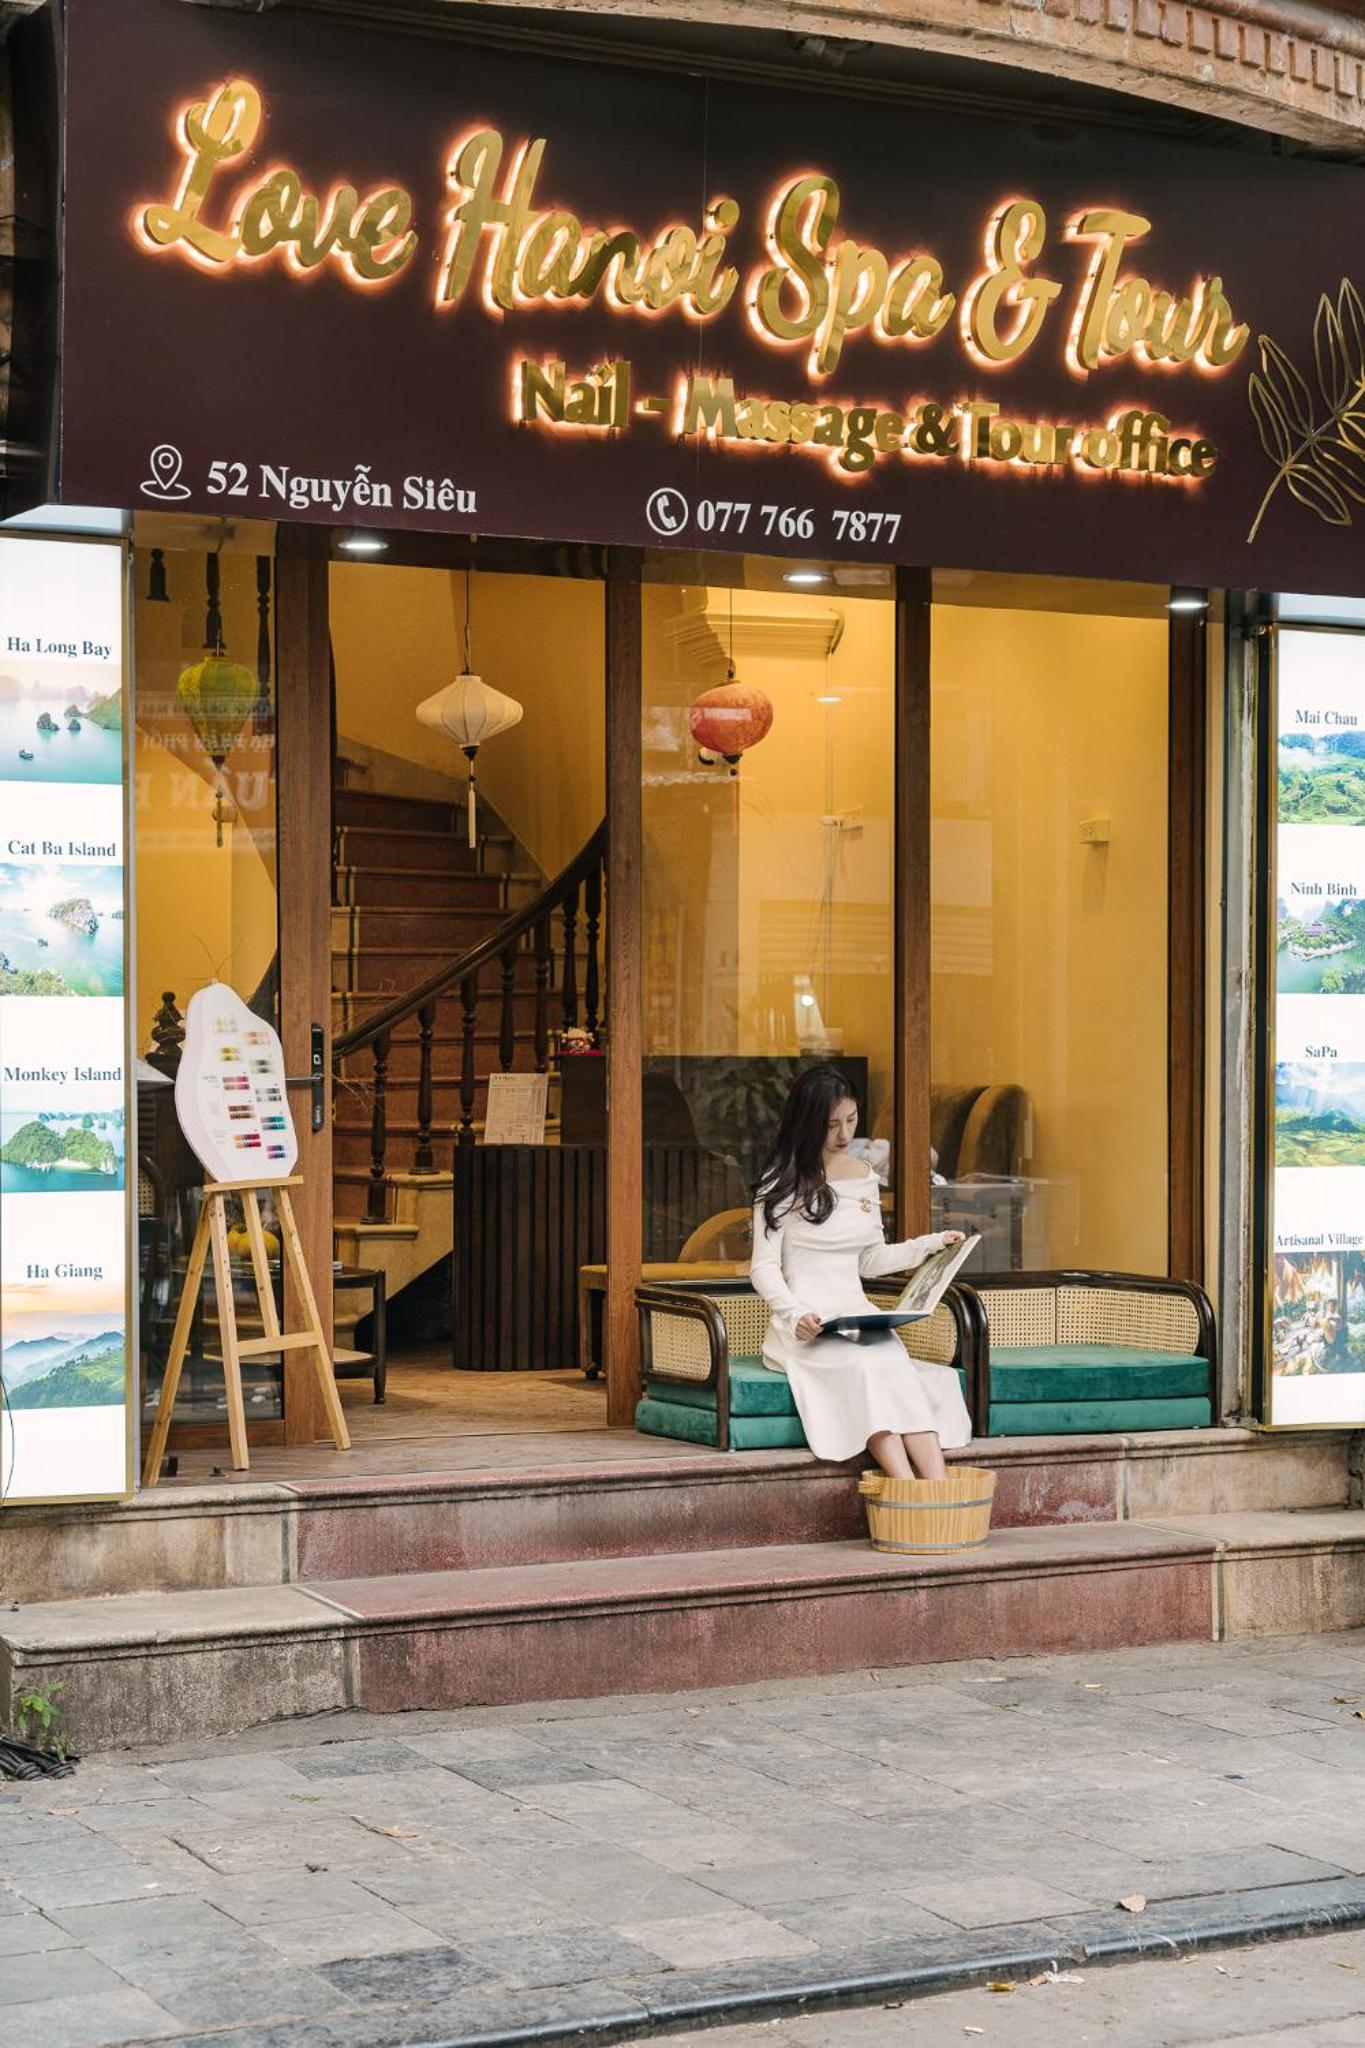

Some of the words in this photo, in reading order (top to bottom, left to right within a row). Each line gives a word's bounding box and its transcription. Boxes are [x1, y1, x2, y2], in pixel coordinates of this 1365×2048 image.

[137, 78, 419, 280] Love
[439, 129, 740, 316] Hanoi
[750, 174, 956, 379] Spa
[962, 198, 1061, 365] &
[1064, 208, 1250, 373] Tour
[515, 358, 631, 427] Nail
[676, 373, 902, 472] Massage
[906, 402, 961, 457] &
[964, 401, 1075, 465] Tour
[1073, 409, 1217, 477] office
[206, 460, 250, 497] 52
[258, 464, 393, 511] Nguyễn
[403, 476, 478, 513] Siêu
[696, 500, 752, 534] 077
[760, 505, 815, 539] 766
[831, 510, 902, 544] 7877
[7, 637, 31, 652] Ha
[36, 638, 77, 657] Long
[82, 641, 112, 659] Bay
[1295, 709, 1321, 725] Mai
[1324, 710, 1358, 726] Chau
[7, 840, 36, 855] Cat
[42, 841, 63, 856] Ba
[68, 841, 117, 857] Island
[1290, 881, 1322, 896] Ninh
[1327, 882, 1358, 897] Binh
[1304, 1045, 1338, 1059] SaPa
[4, 1066, 68, 1085] Monkey
[74, 1066, 122, 1082] Island
[1275, 1234, 1325, 1247] Artisanal
[1327, 1232, 1365, 1248] Village
[26, 1264, 49, 1279] Ha
[55, 1263, 104, 1281] Giang
